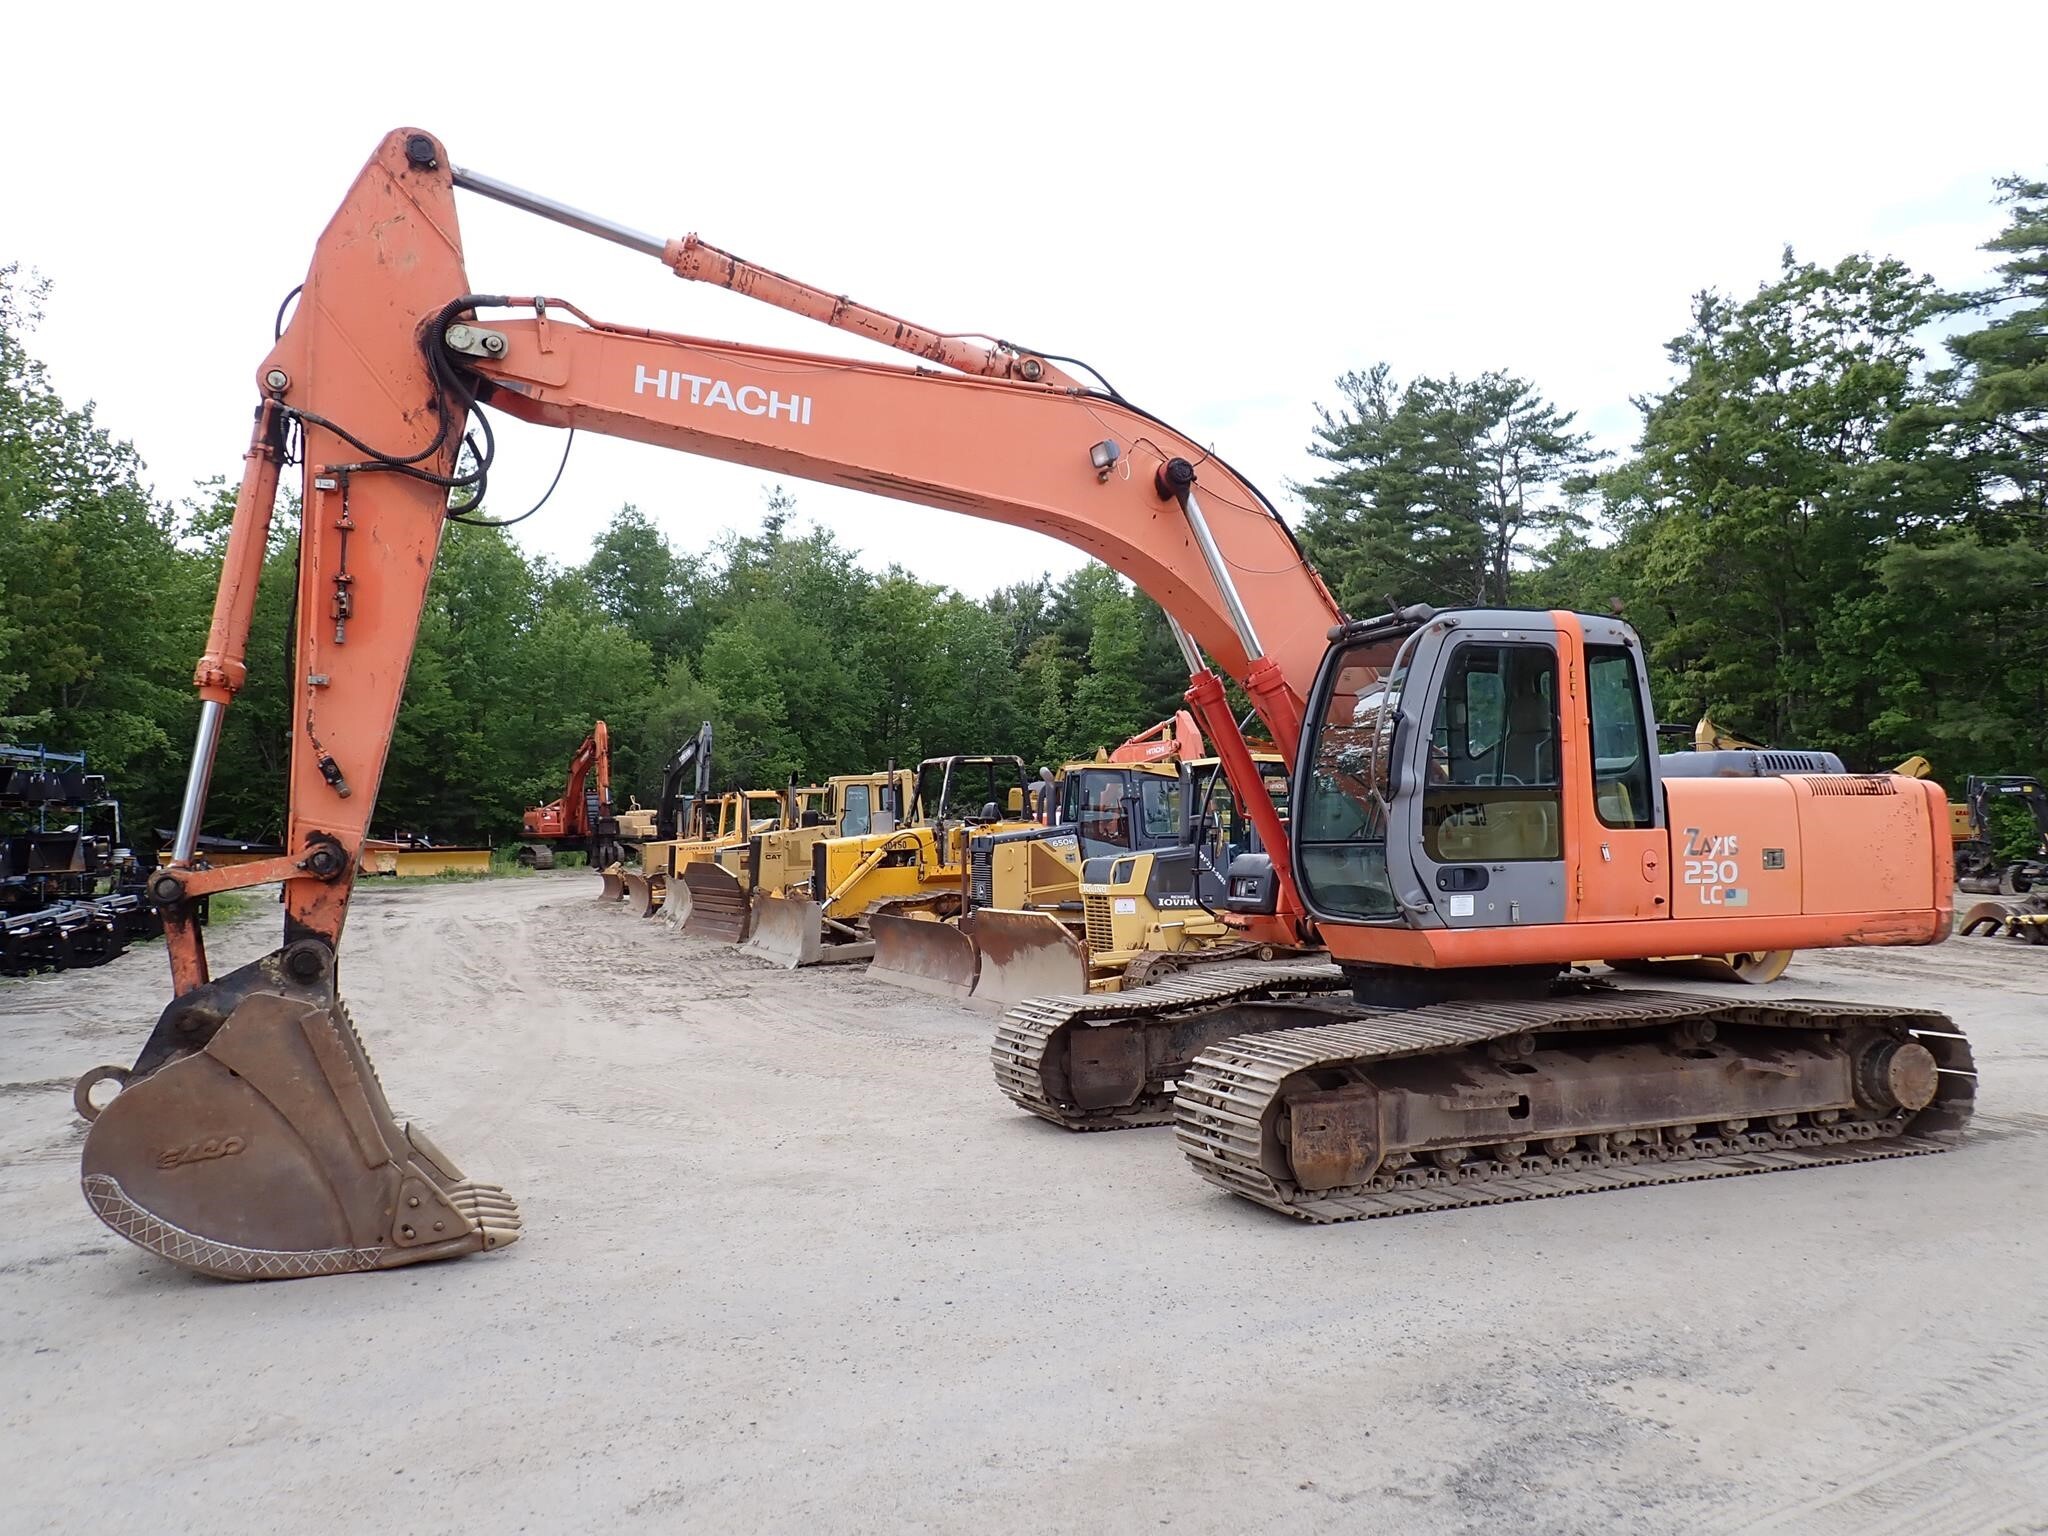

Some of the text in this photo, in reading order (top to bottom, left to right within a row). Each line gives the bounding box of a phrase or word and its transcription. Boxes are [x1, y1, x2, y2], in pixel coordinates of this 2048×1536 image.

[634, 364, 812, 425] HITACHI
[1684, 860, 1739, 884] 230
[1700, 885, 1723, 905] LC
